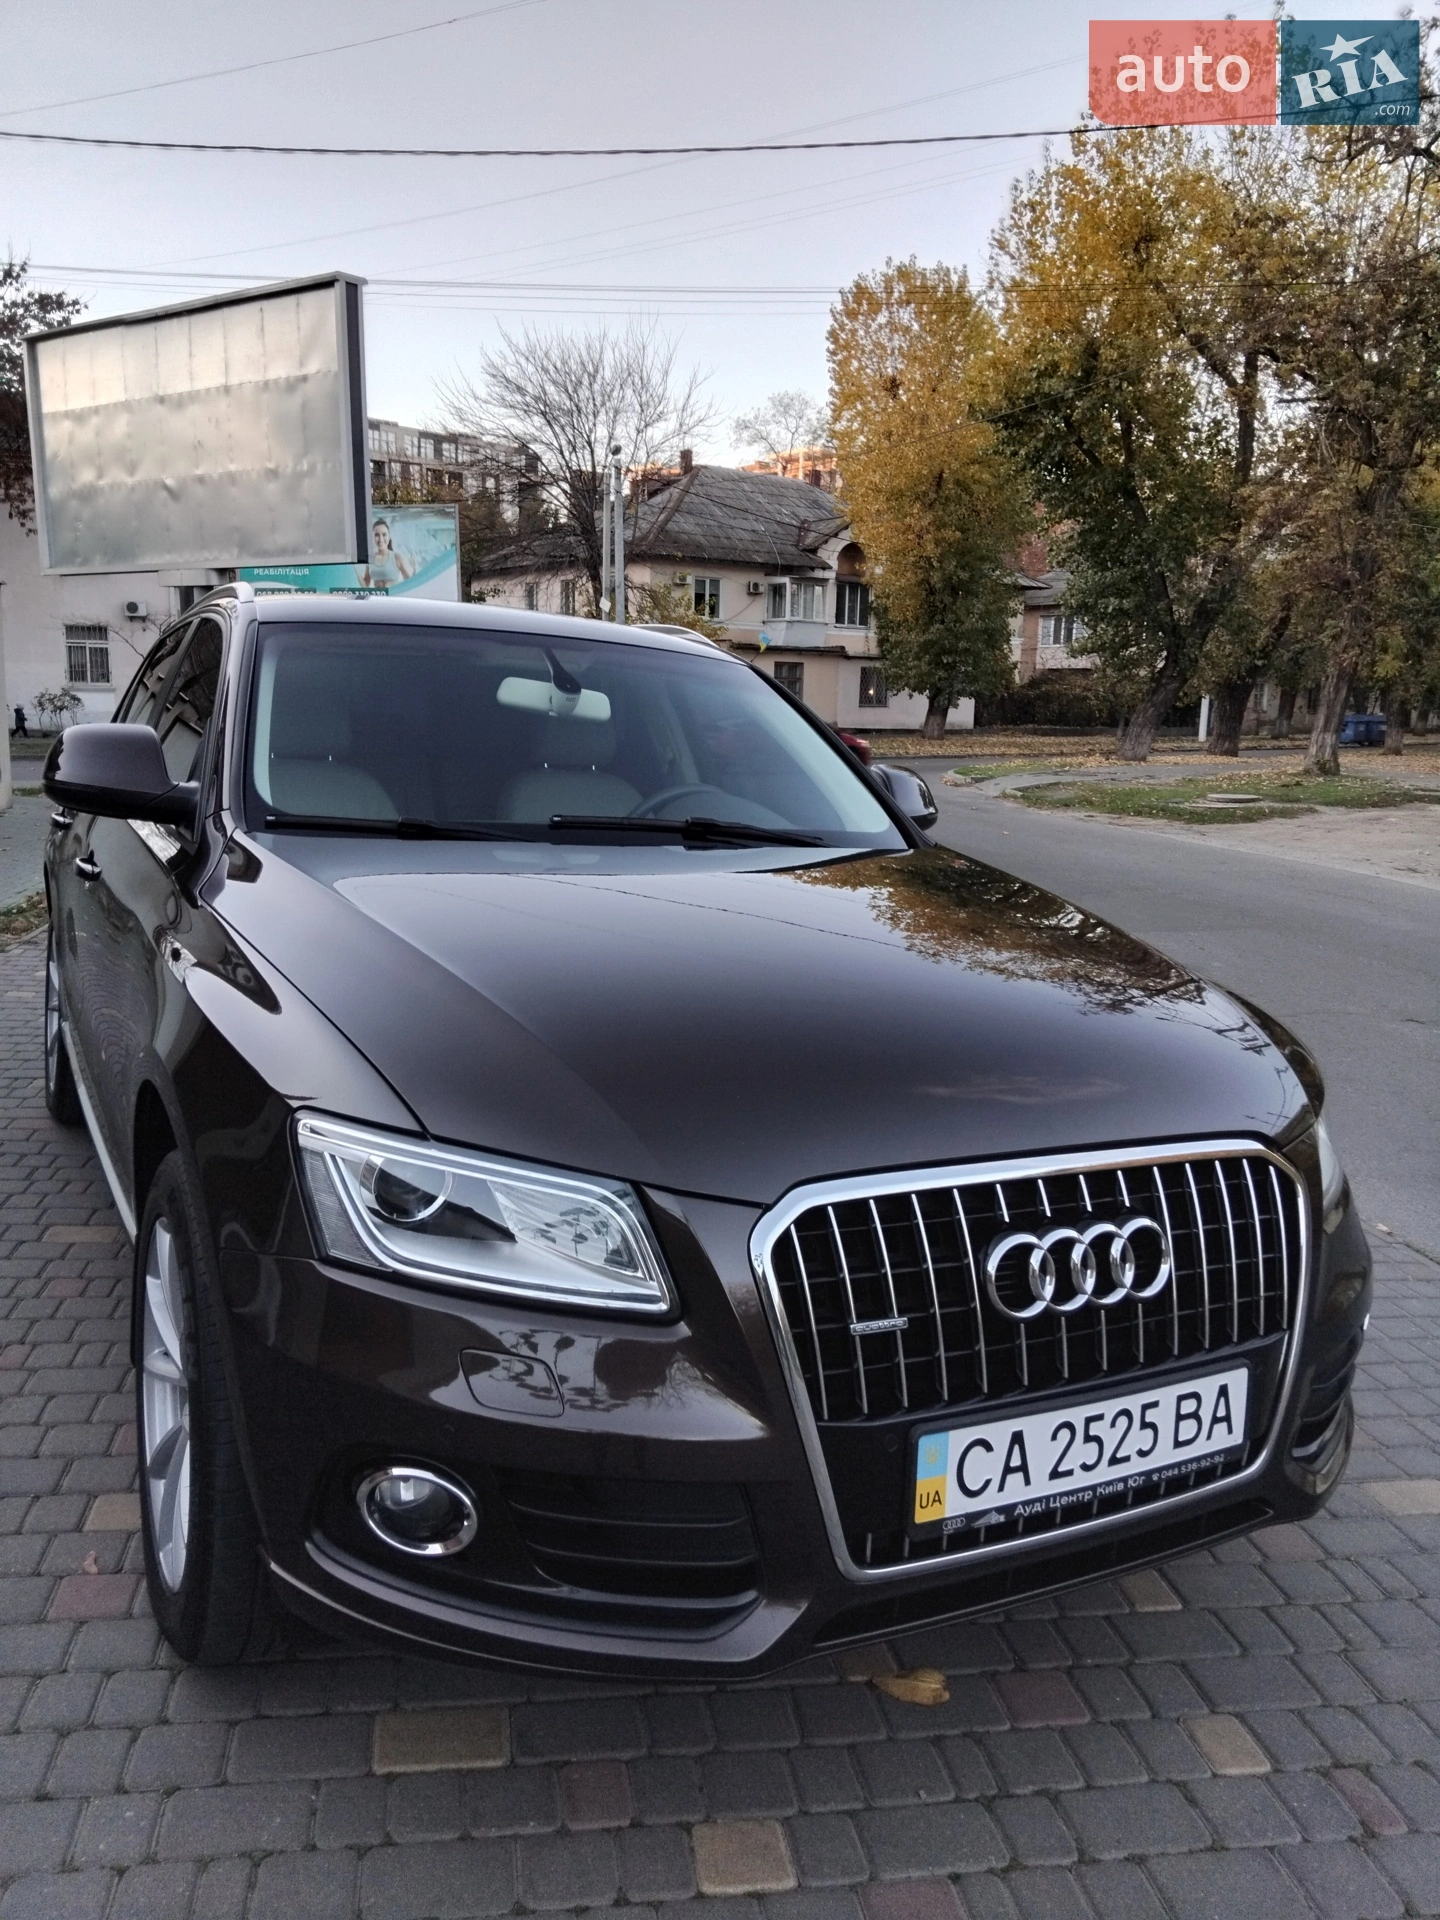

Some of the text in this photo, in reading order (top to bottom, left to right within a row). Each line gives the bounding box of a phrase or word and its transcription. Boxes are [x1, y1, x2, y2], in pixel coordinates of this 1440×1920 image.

[253, 568, 310, 576] РЕАБІЛІТАЦІЯ
[855, 1320, 904, 1332] quattro
[956, 1383, 1233, 1498] CA 2525 BA
[918, 1490, 943, 1509] UA
[1013, 1499, 1046, 1517] Ауді
[1049, 1490, 1093, 1508] Центр
[1096, 1482, 1124, 1496] Київ
[1127, 1476, 1146, 1488] Юг
[1160, 1468, 1179, 1479] 044
